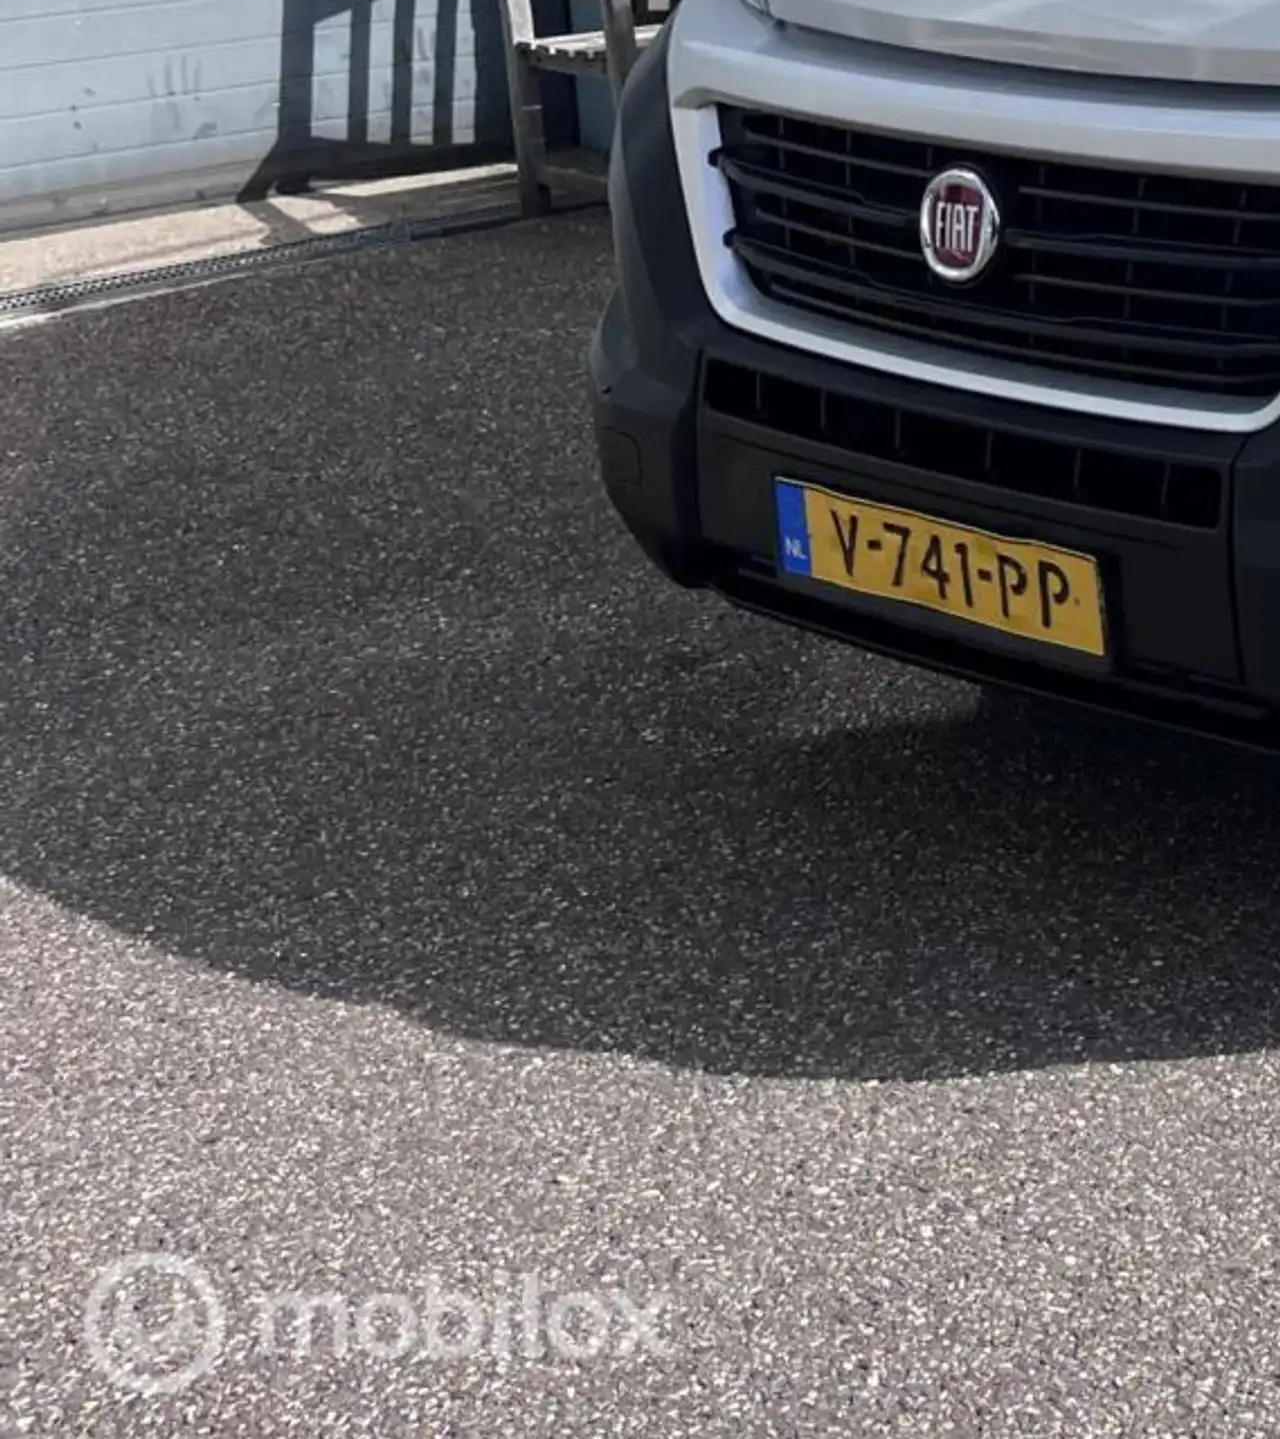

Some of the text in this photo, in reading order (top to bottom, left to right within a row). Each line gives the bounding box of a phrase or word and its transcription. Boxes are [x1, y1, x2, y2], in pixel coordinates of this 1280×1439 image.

[935, 200, 980, 253] FIAT
[784, 536, 808, 560] NL
[830, 508, 1070, 629] V-741-PP
